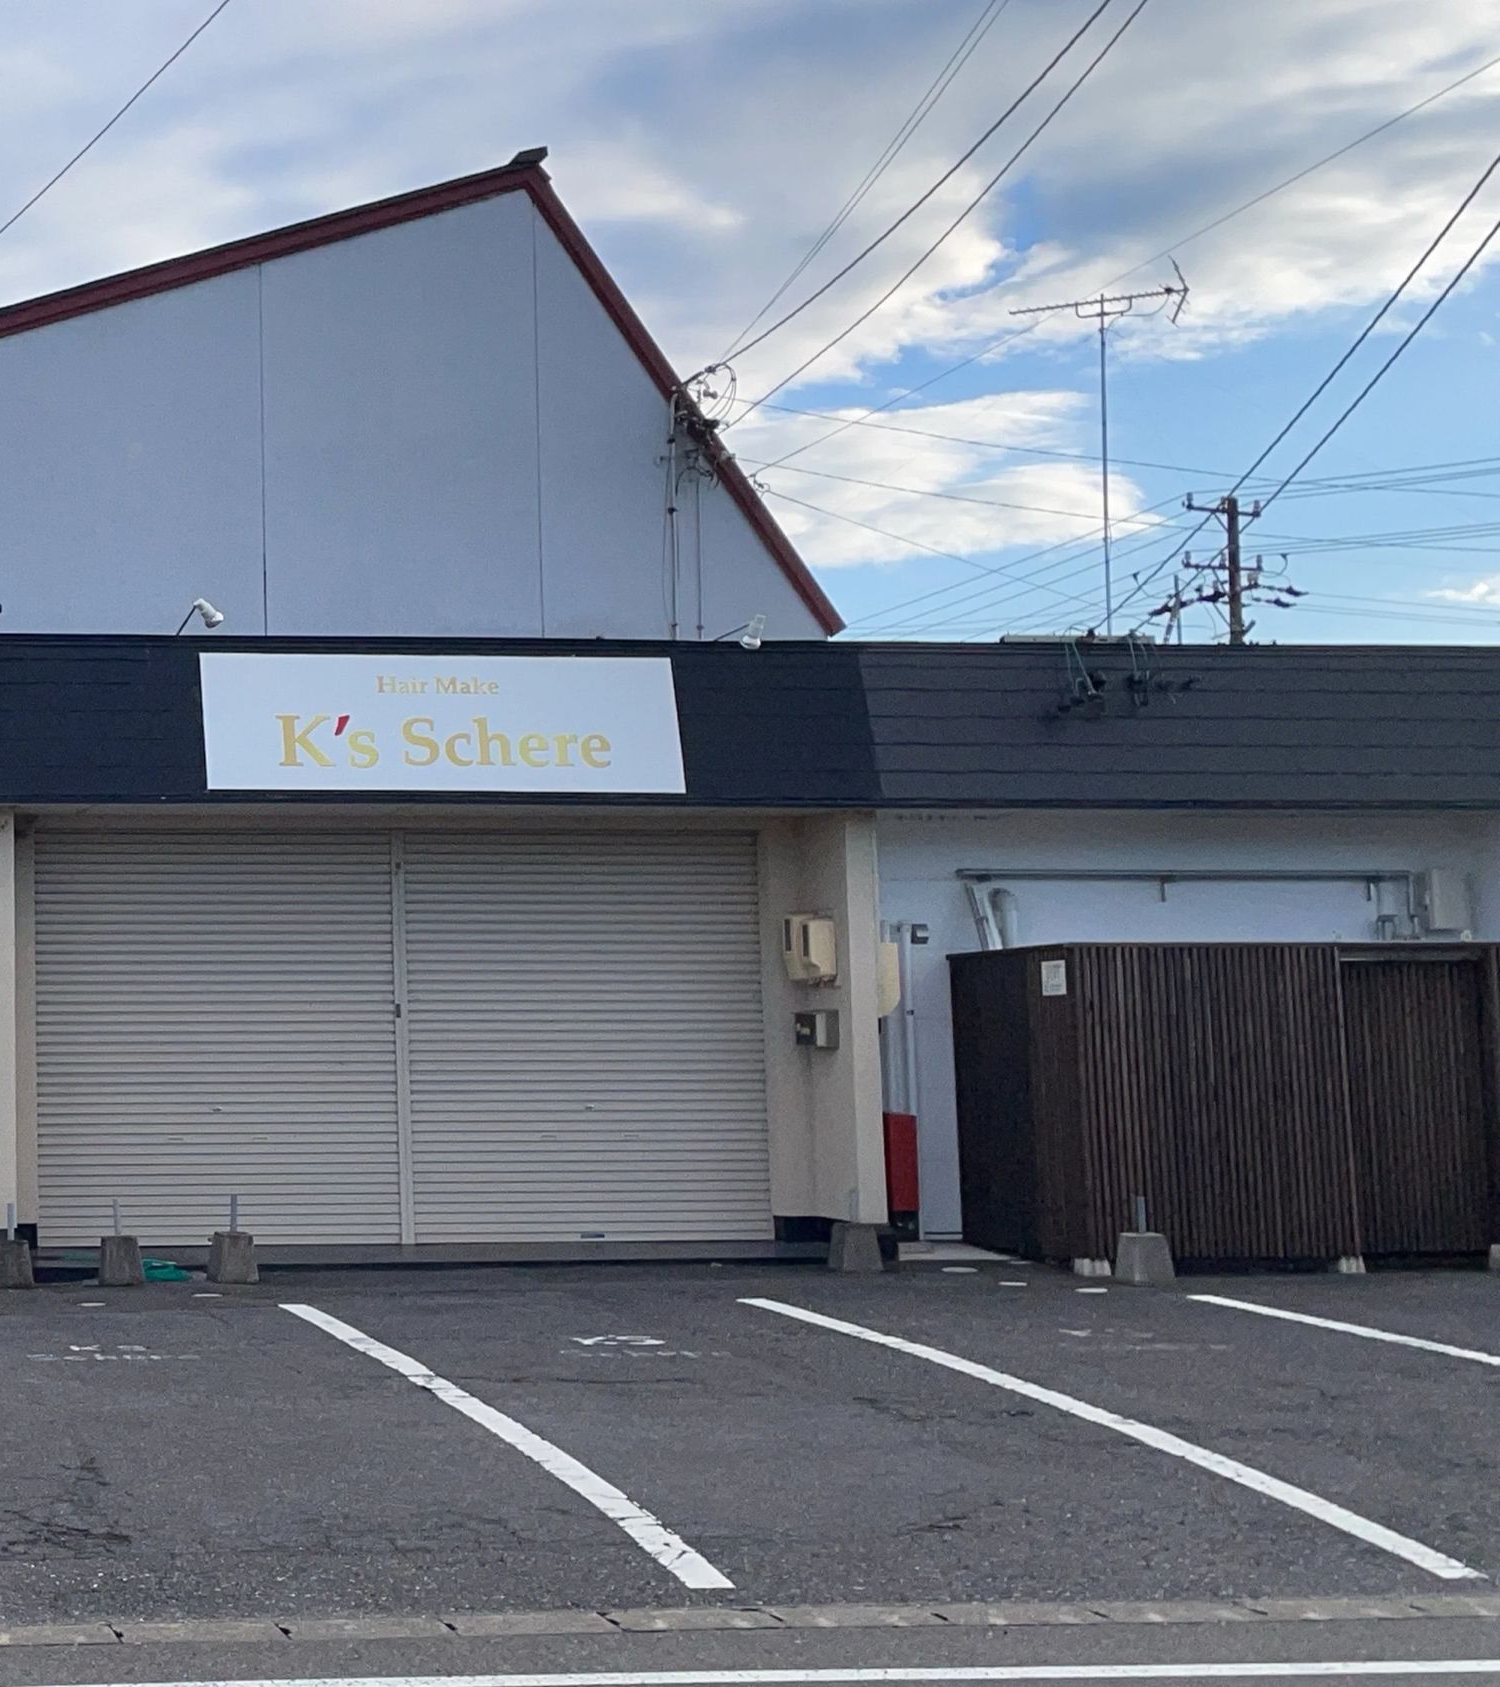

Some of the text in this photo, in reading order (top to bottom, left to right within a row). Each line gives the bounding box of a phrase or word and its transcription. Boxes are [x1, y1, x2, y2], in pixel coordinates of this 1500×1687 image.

[376, 675, 499, 695] Hair Make
[275, 714, 612, 768] K's Schere
